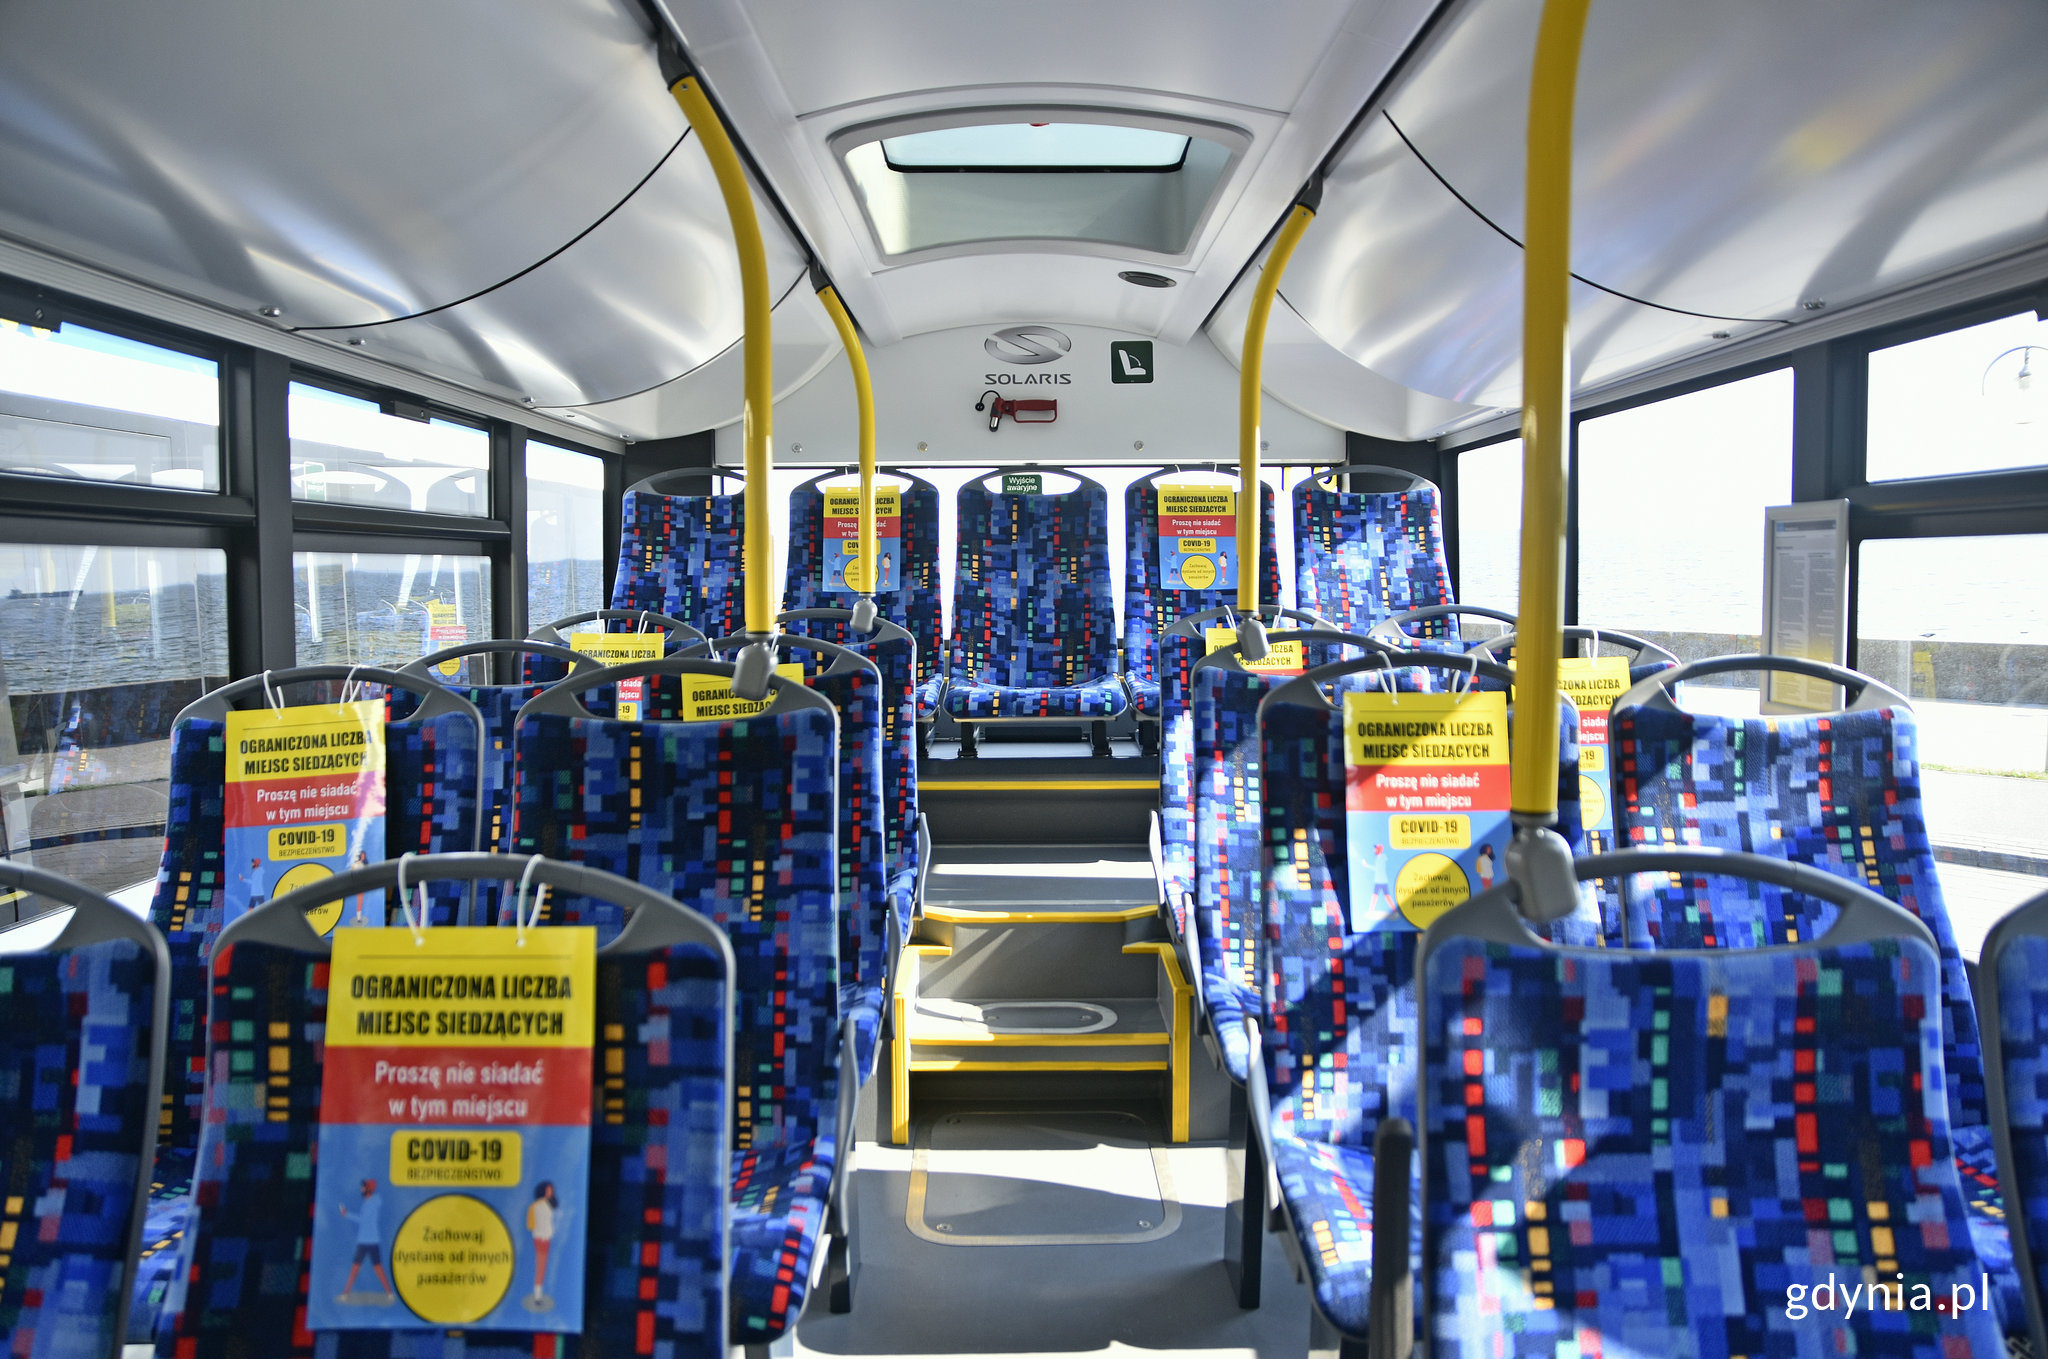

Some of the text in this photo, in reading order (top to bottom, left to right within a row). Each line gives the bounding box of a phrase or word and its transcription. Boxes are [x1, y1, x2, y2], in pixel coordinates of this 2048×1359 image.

[985, 374, 1071, 385] SOLARIS
[1009, 476, 1036, 485] Wyjście
[1007, 484, 1037, 493] awaryjne
[876, 497, 894, 505] ICZBA
[1207, 495, 1228, 503] LICZBA
[1166, 505, 1226, 513] MIEJSC SIEDZĄCYCH
[1172, 519, 1192, 527] Proszę
[1203, 518, 1221, 526] siadać
[1195, 528, 1217, 536] miejscu
[631, 649, 656, 658] LICZBA
[1271, 644, 1293, 653] ICZBA
[1589, 679, 1620, 690] LICZBA
[619, 691, 639, 700] iejscu
[692, 689, 735, 702] OGRANIC
[696, 704, 730, 717] MIEJSC
[1358, 722, 1493, 737] OGRANICZONA LICZBA
[240, 730, 372, 754] OGRANICZONA LICZBA
[1363, 743, 1489, 760] MIEJSC SIEDZĄCYCH
[244, 752, 367, 775] MIEJSC SIEDZĄCYCH
[1376, 772, 1480, 791] Proszę nie siadać
[257, 781, 357, 802] Proszę nie siadać
[1386, 793, 1472, 810] w tym miejscu
[266, 804, 349, 823] w tym miejscu
[1400, 820, 1458, 834] COVID-19
[278, 829, 335, 846] COVID-19
[351, 975, 572, 1000] OGRANICZONA LICZBA
[356, 1011, 564, 1040] MIEJSC SIEDZĄCYCH
[375, 1058, 545, 1089] Proszę nie siadać
[388, 1094, 529, 1122] w tym miejscu
[407, 1138, 503, 1162] COVID-19
[423, 1227, 485, 1245] Zachowaj
[448, 1250, 463, 1263] od
[468, 1250, 510, 1266] innych
[417, 1270, 487, 1288] pasażerów
